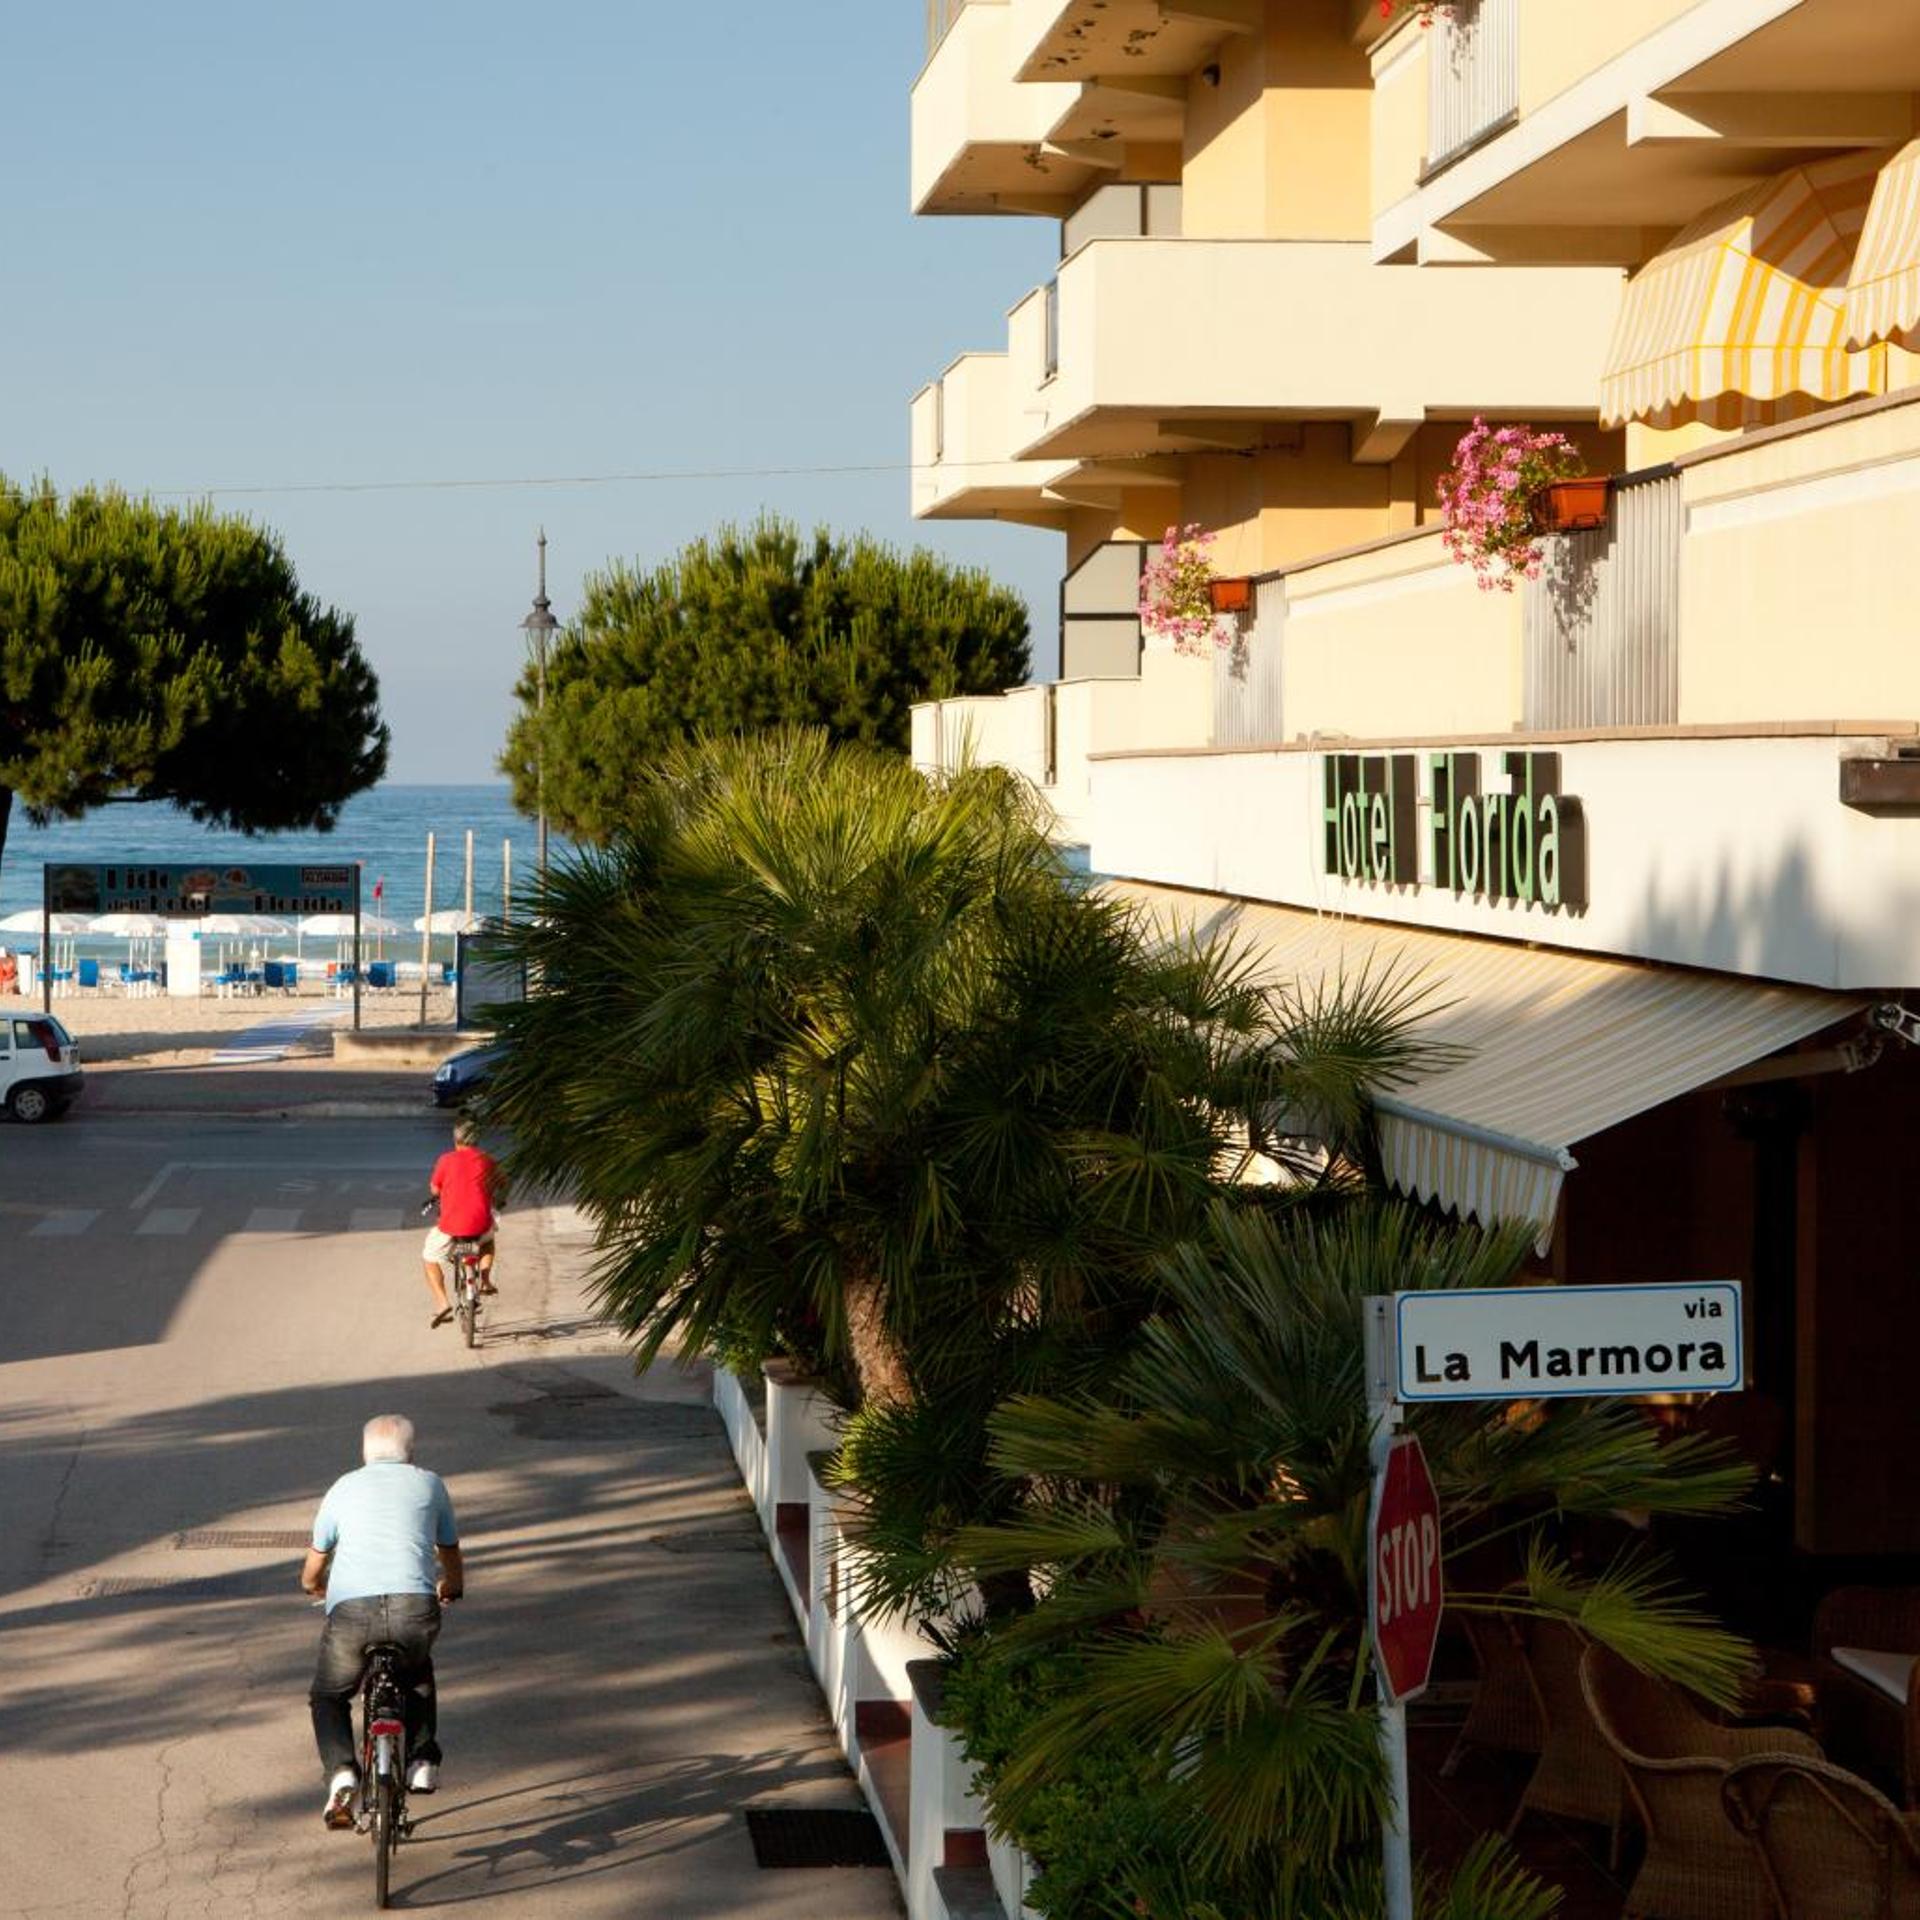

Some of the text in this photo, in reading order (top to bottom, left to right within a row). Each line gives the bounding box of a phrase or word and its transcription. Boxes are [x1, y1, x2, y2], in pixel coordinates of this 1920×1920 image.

[1323, 751, 1564, 905] Hotel Florida
[1683, 1297, 1722, 1319] via
[1414, 1339, 1726, 1383] La Marmora
[1379, 1512, 1436, 1626] STOP
